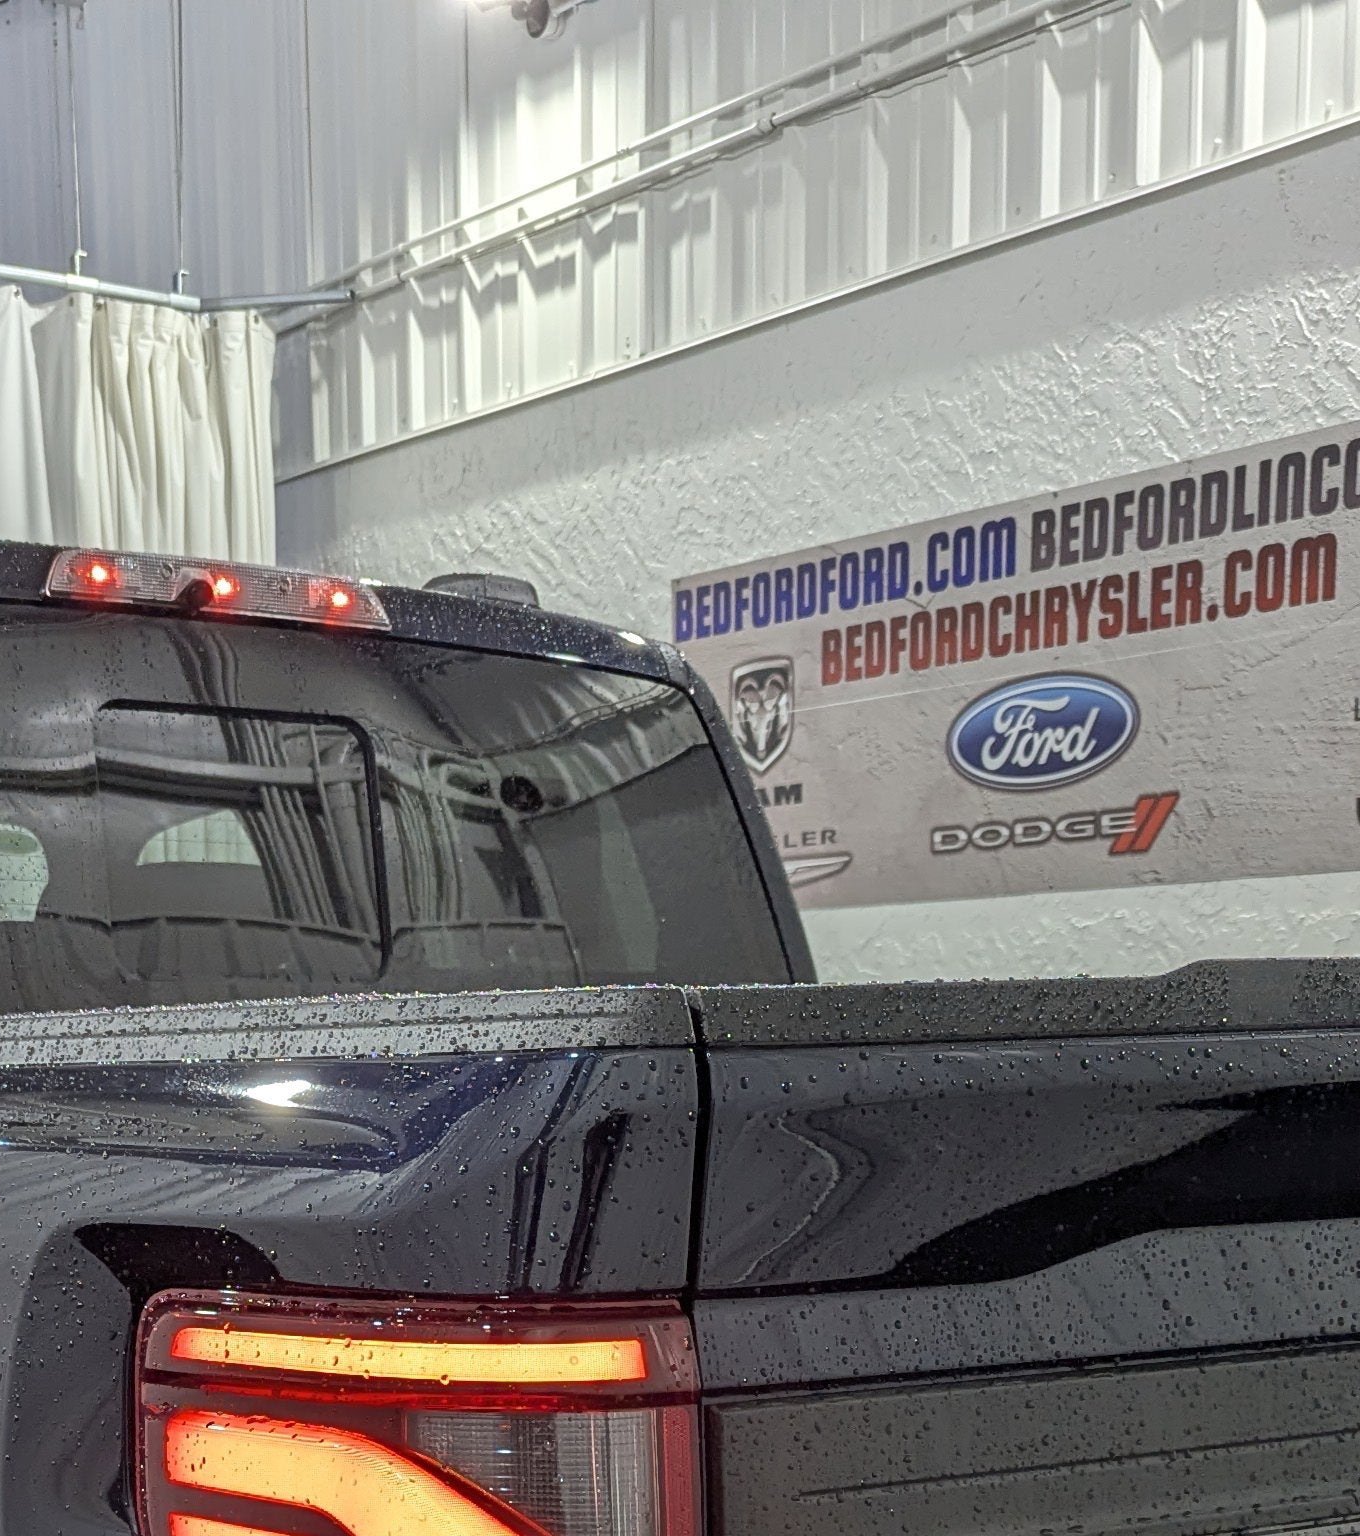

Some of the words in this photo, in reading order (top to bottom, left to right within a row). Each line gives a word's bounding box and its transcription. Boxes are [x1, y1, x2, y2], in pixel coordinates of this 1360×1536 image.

[676, 516, 1016, 643] BEDFORDFORD.COM
[821, 533, 1337, 687] BEDFORDCHRYSLER.COM
[981, 696, 1100, 770] Ford
[930, 807, 1137, 855] DODGE
